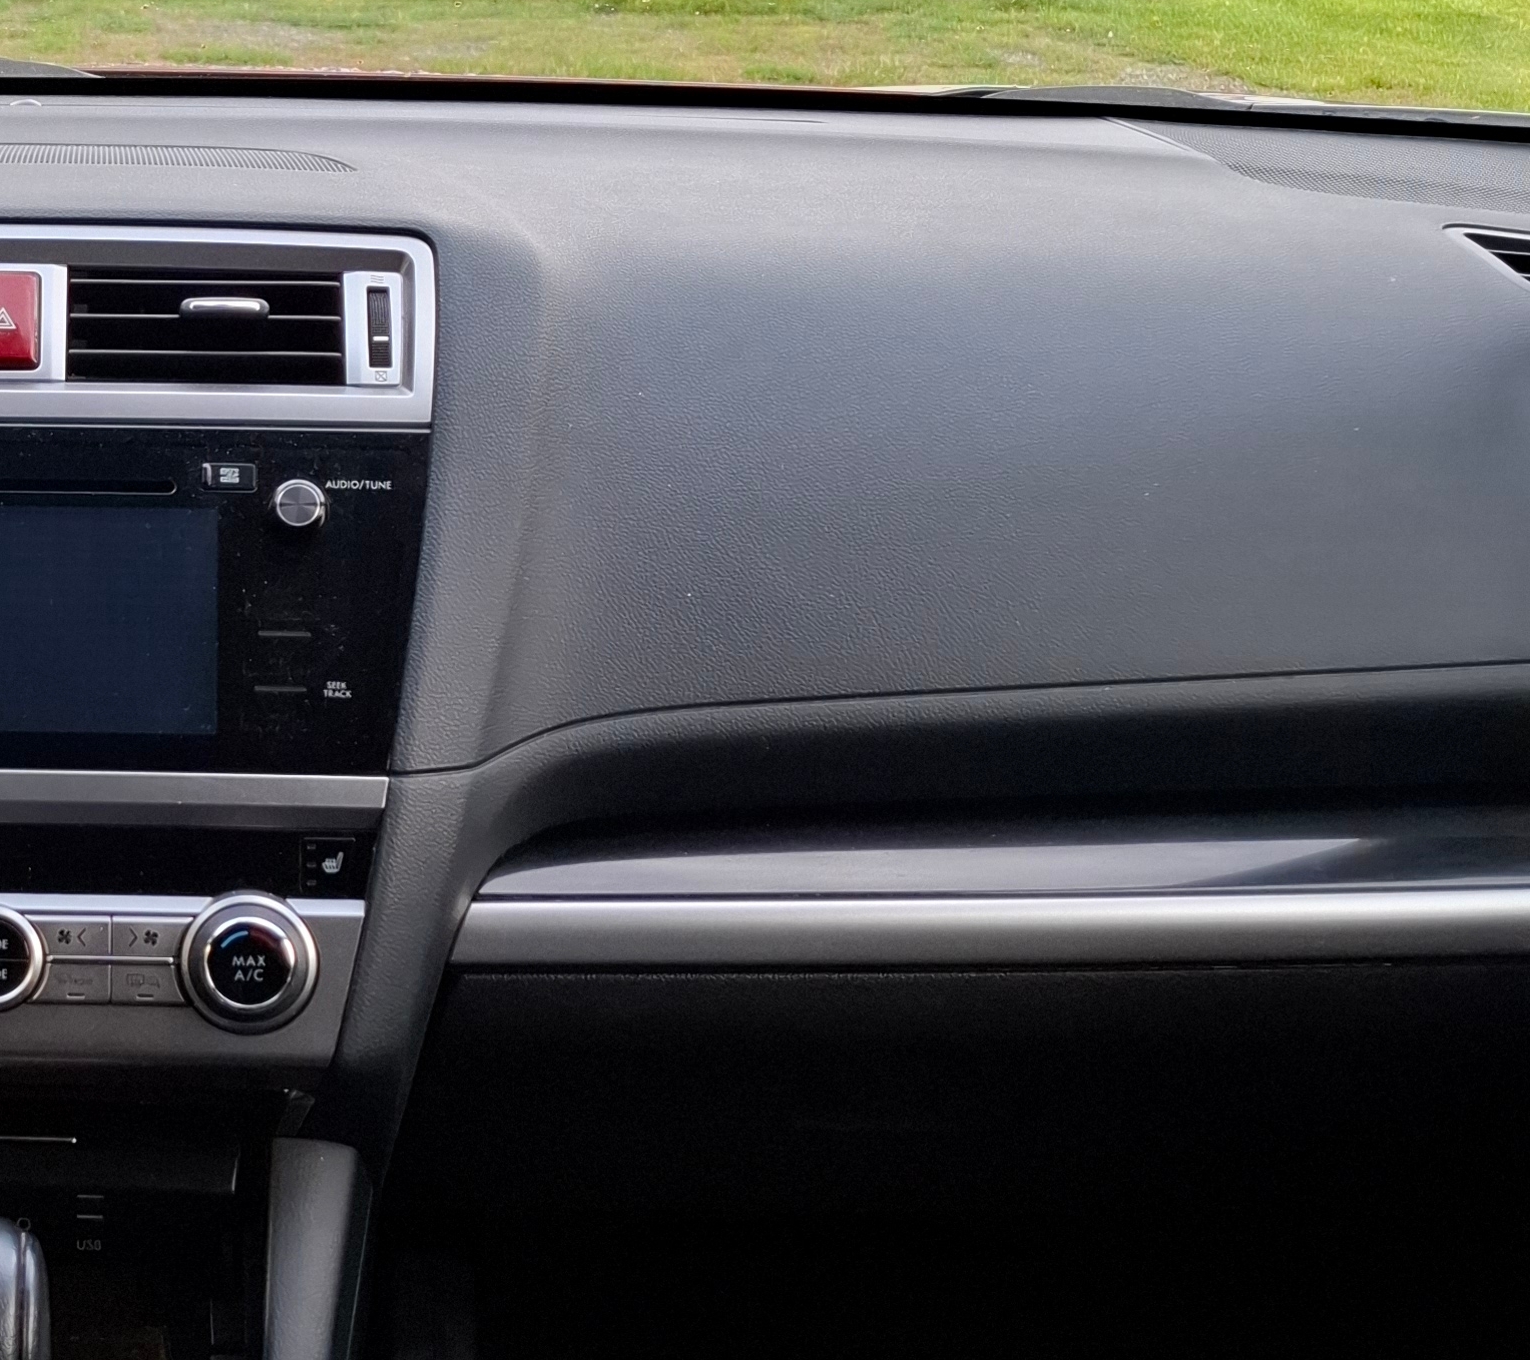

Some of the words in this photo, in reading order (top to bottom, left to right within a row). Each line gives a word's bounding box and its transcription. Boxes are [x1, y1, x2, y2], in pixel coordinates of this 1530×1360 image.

[324, 480, 392, 490] AUDIO/TUNE
[326, 680, 348, 690] SEEK
[323, 689, 353, 699] TRACK
[231, 955, 267, 967] MAX
[233, 968, 264, 982] A/C
[76, 1238, 103, 1252] USB
